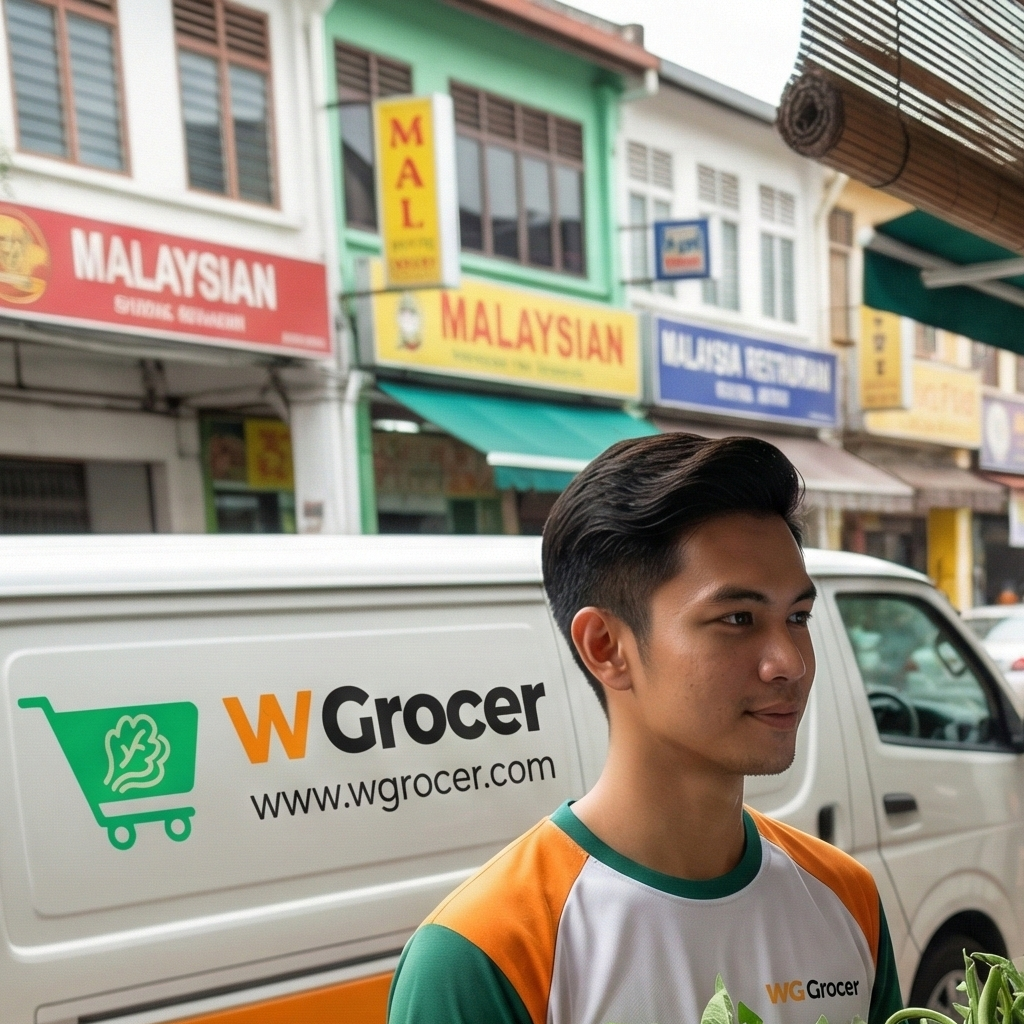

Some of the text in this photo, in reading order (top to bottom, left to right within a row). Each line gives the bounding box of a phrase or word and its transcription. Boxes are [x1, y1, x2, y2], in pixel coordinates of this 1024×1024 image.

[389, 115, 424, 229] MAL
[70, 227, 278, 311] MALAYSIAN
[440, 289, 624, 366] MALAYSIAN
[250, 755, 557, 821] www.wgrocer.com
